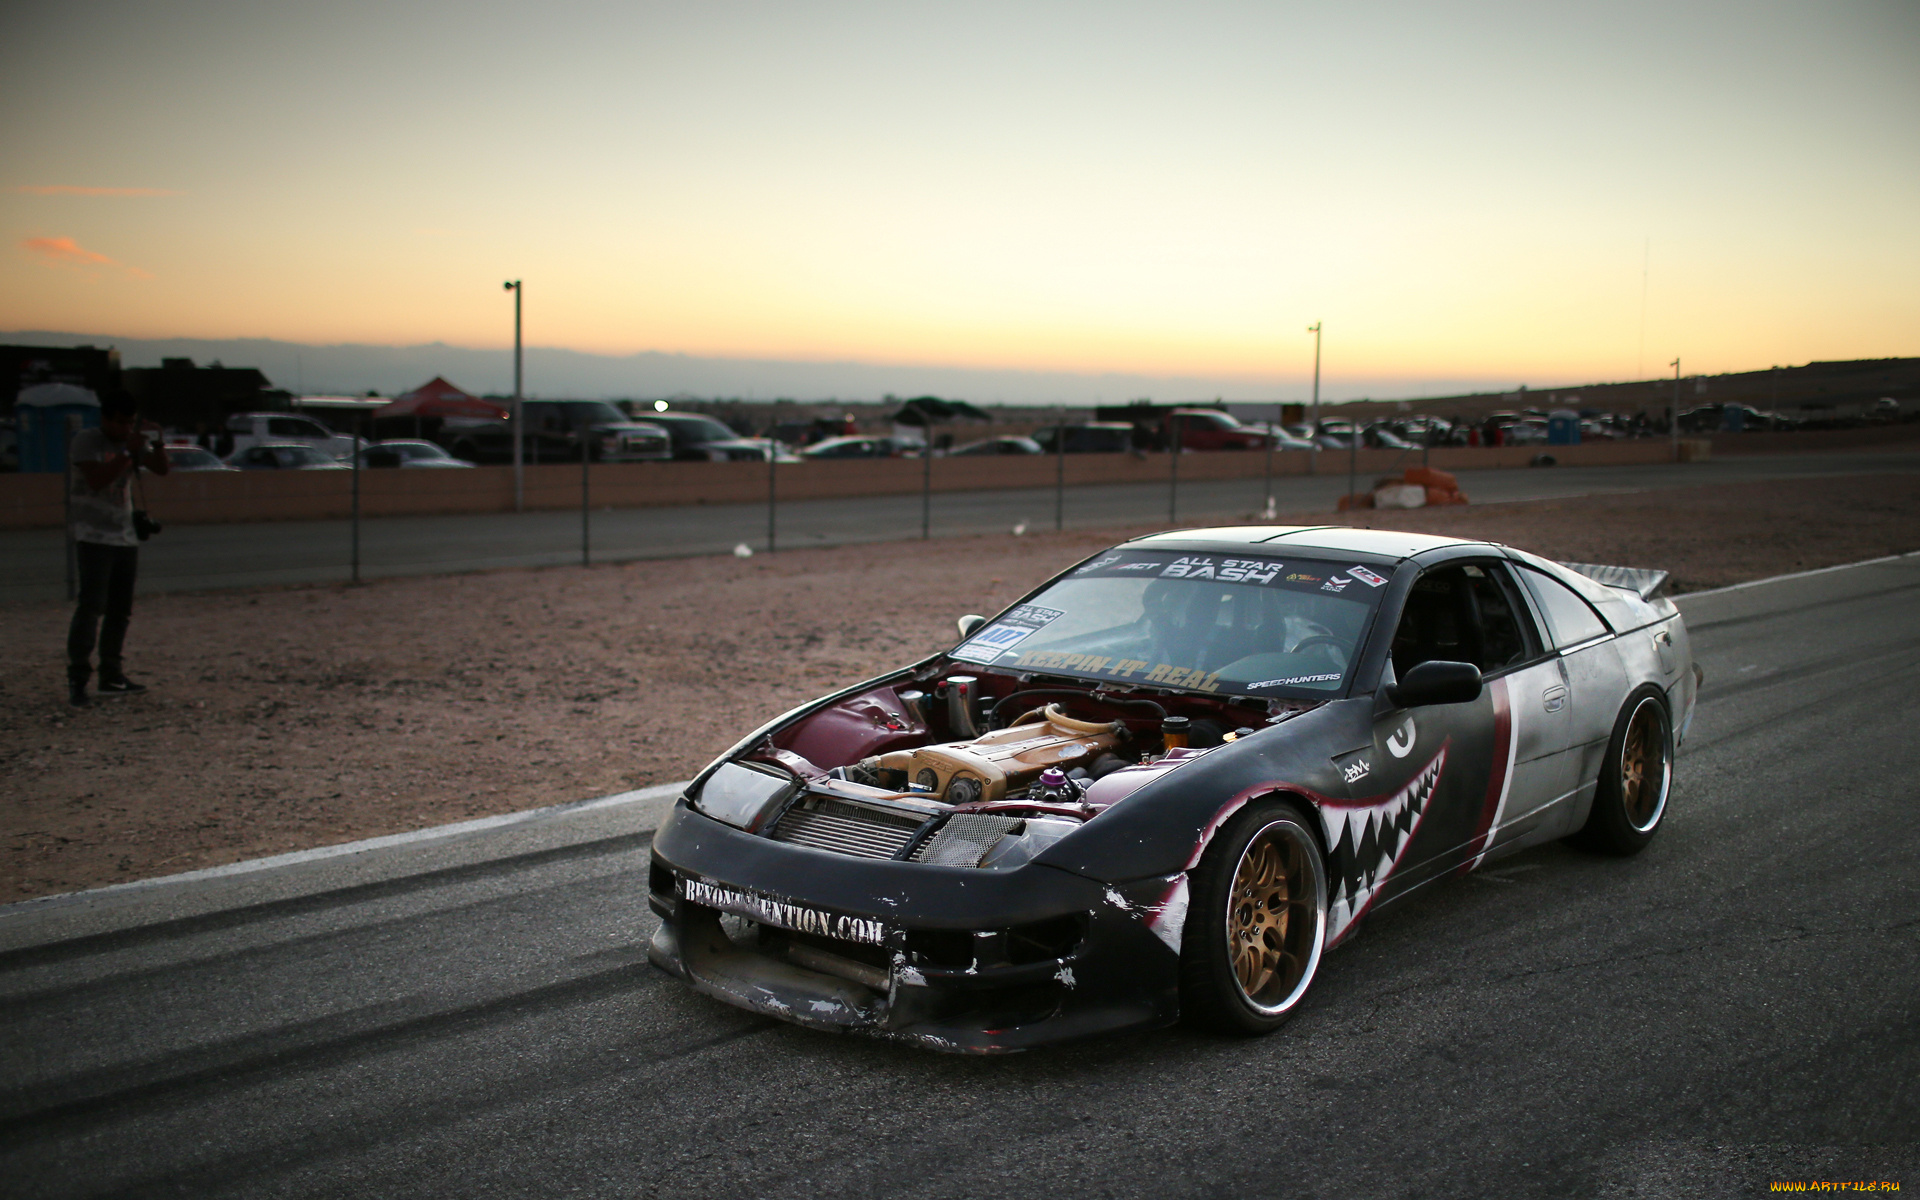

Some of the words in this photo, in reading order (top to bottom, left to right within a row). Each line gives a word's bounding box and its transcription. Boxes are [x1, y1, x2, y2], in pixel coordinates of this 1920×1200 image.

[1172, 556, 1214, 567] ALL
[1220, 558, 1284, 572] STAR
[1158, 564, 1278, 585] BASH
[1013, 650, 1112, 673] KEEPIN
[1107, 658, 1149, 677] IT
[1143, 663, 1220, 692] REAL
[1247, 673, 1342, 690] SPEEDHUNTERS
